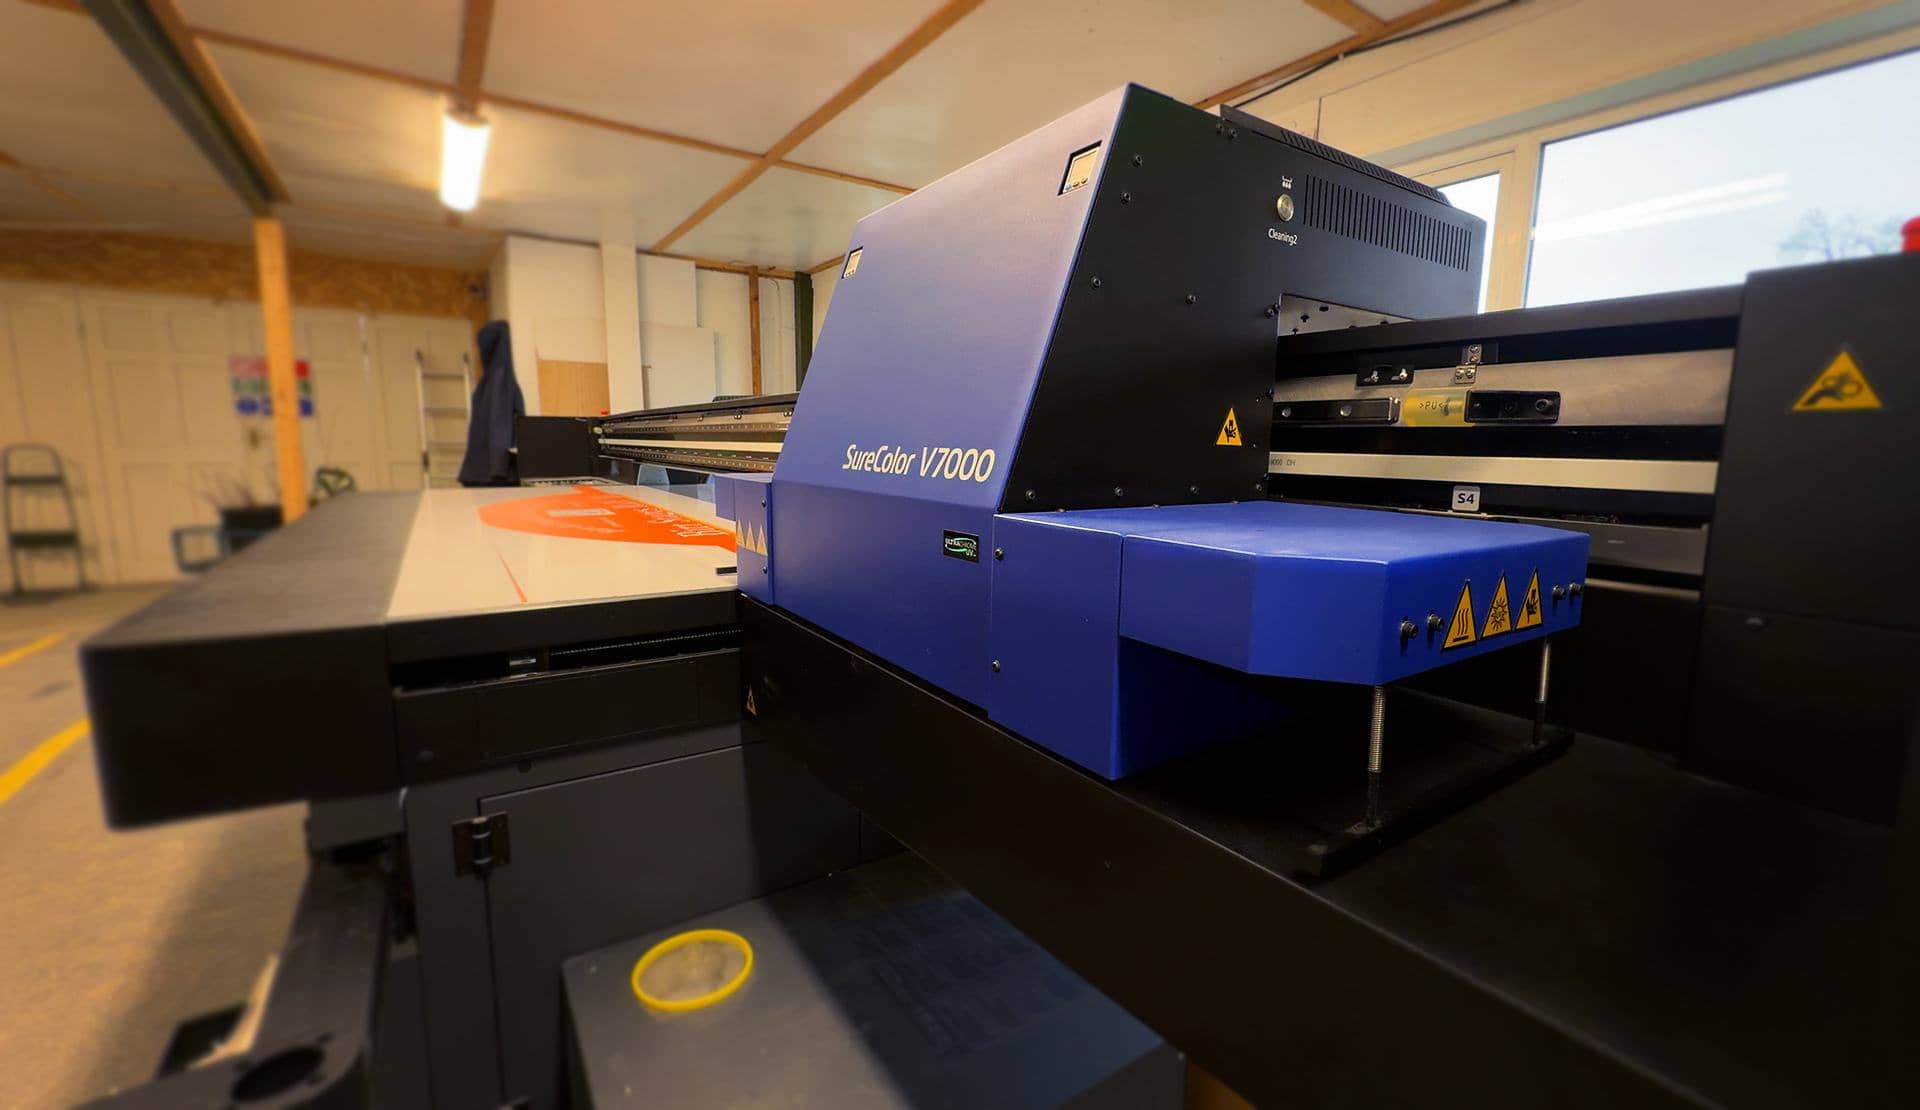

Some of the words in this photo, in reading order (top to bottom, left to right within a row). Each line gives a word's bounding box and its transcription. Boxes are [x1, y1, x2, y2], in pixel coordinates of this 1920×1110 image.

[1268, 228, 1298, 246] Cleaning2
[842, 444, 916, 476] SureColor
[919, 446, 996, 483] V7000
[1457, 493, 1474, 504] S4
